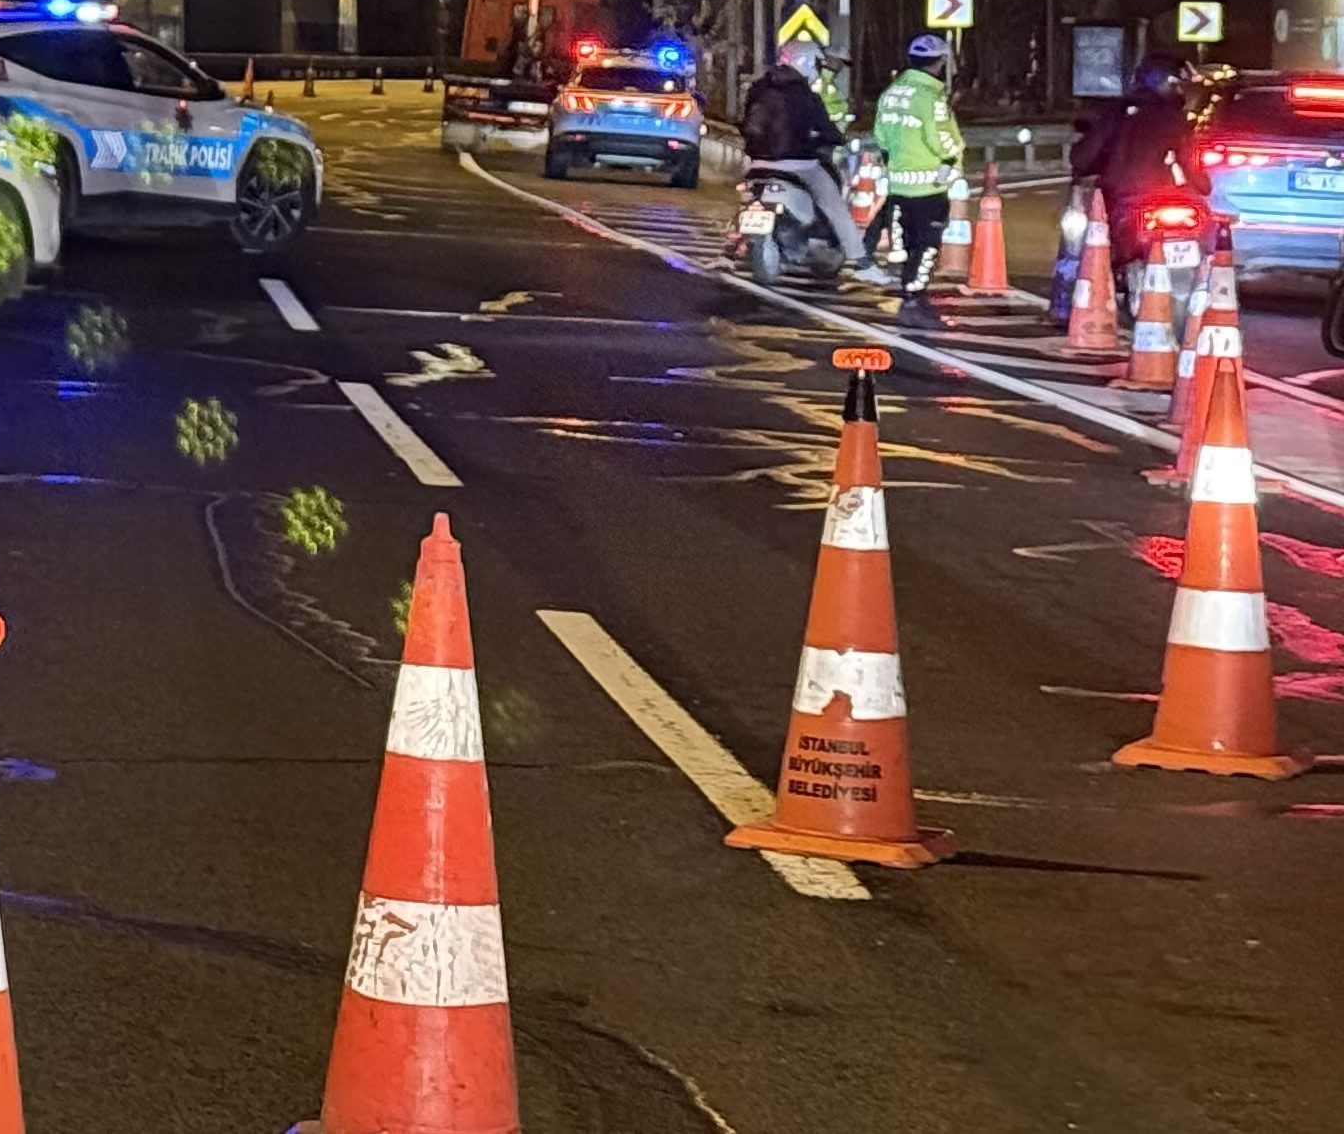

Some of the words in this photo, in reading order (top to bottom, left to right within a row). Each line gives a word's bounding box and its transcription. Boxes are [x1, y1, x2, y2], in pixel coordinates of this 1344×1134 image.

[190, 142, 233, 171] POLİSİ
[799, 733, 870, 756] İSTANBUL
[788, 754, 882, 780] BÜYÜKŞEHİR
[788, 778, 878, 802] BELEDİYESİ
